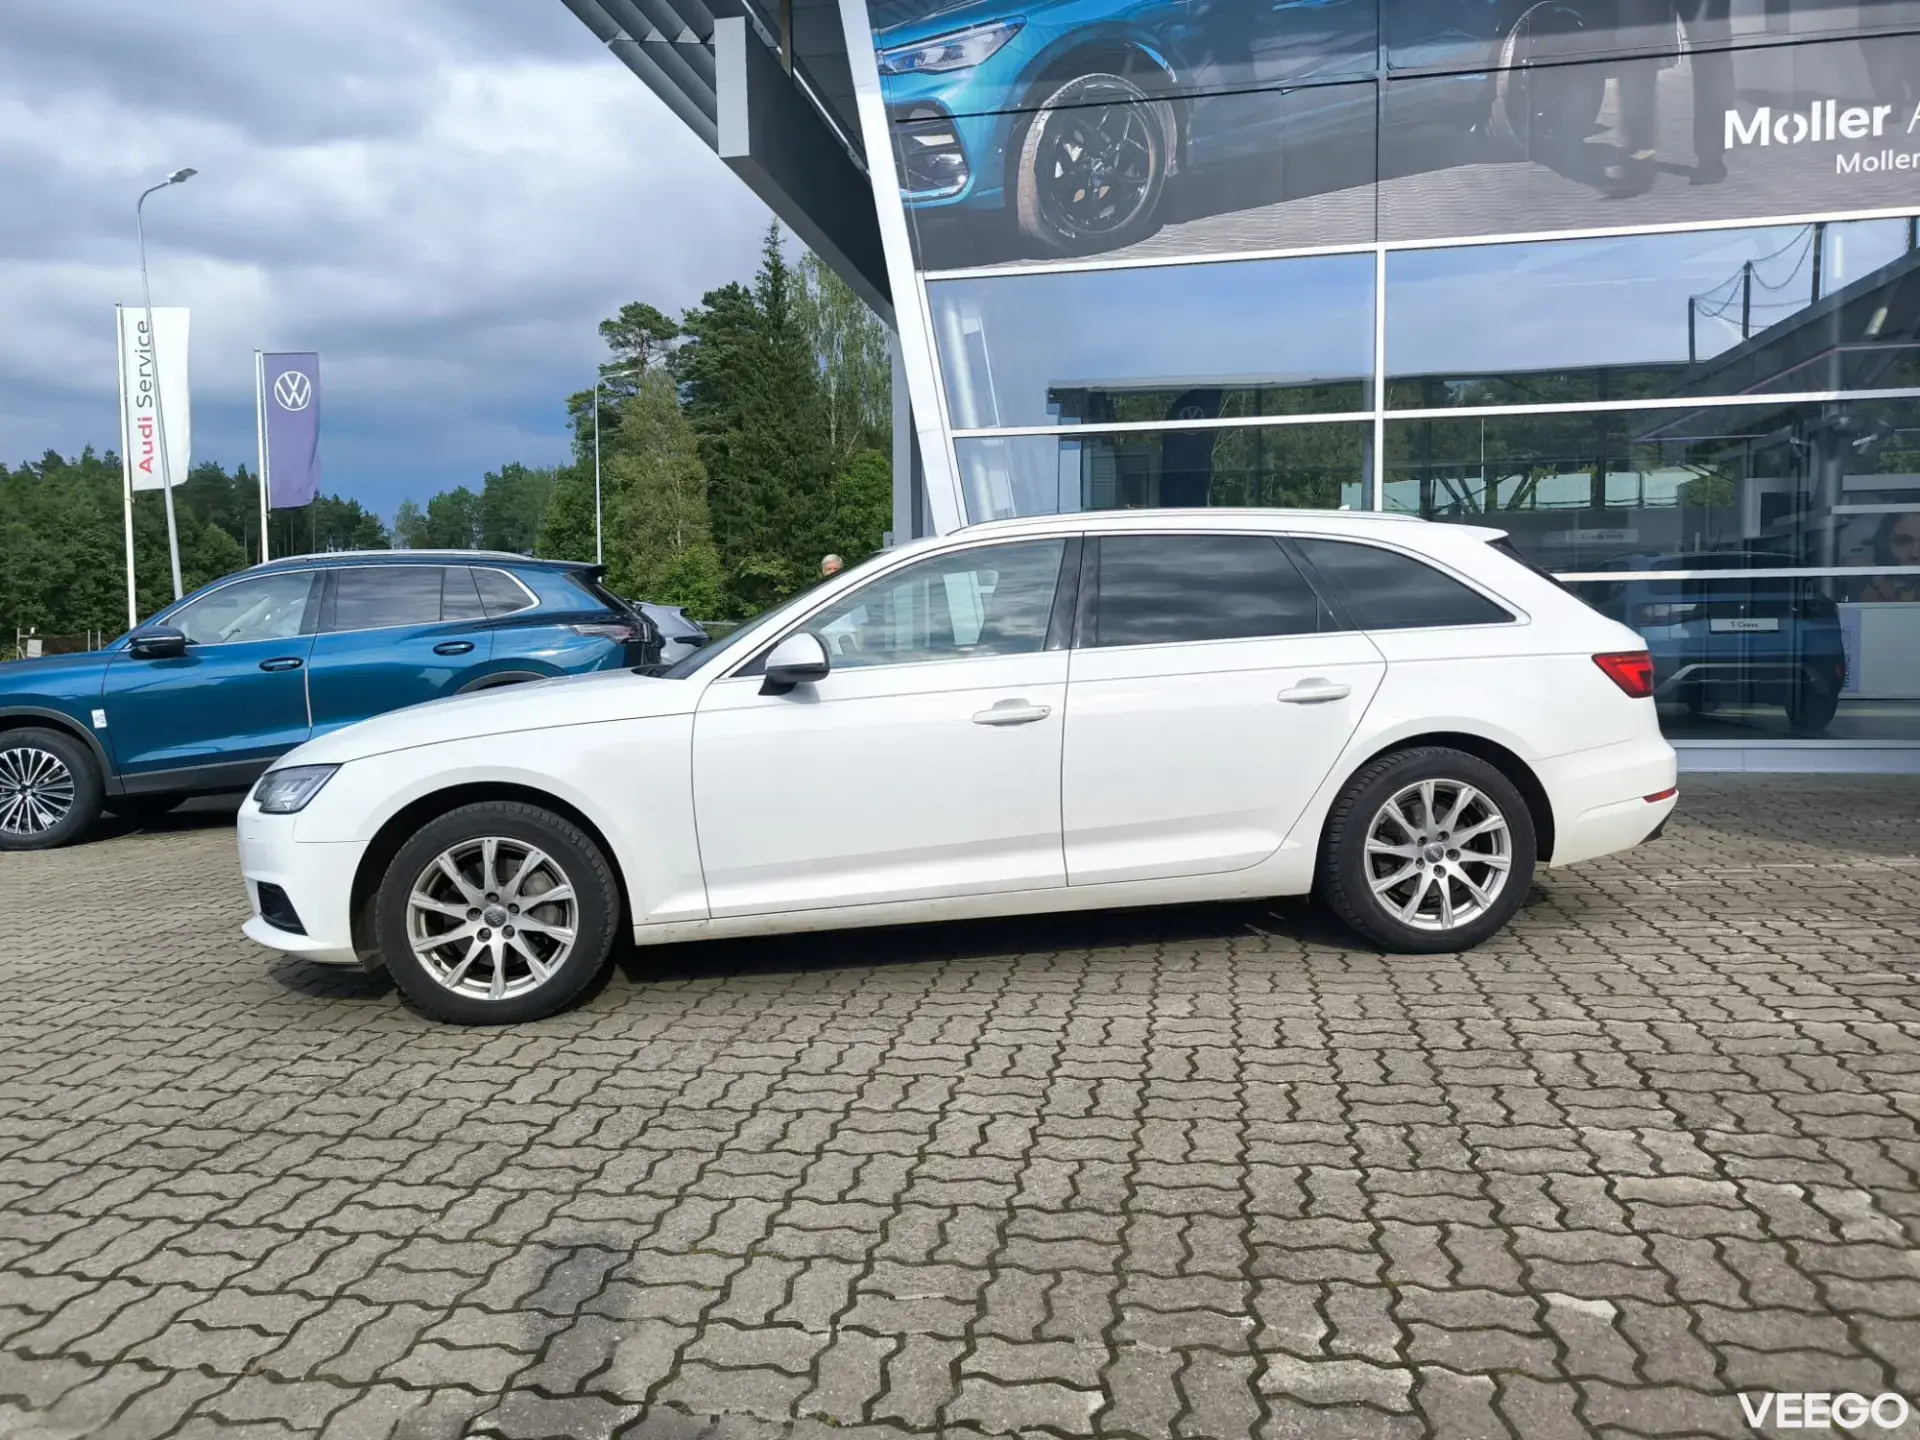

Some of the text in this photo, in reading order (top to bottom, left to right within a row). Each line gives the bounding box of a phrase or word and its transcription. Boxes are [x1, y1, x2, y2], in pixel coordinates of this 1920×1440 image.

[1724, 99, 1892, 149] Moller
[1836, 149, 1920, 174] Moller
[134, 320, 154, 474] Audi Service
